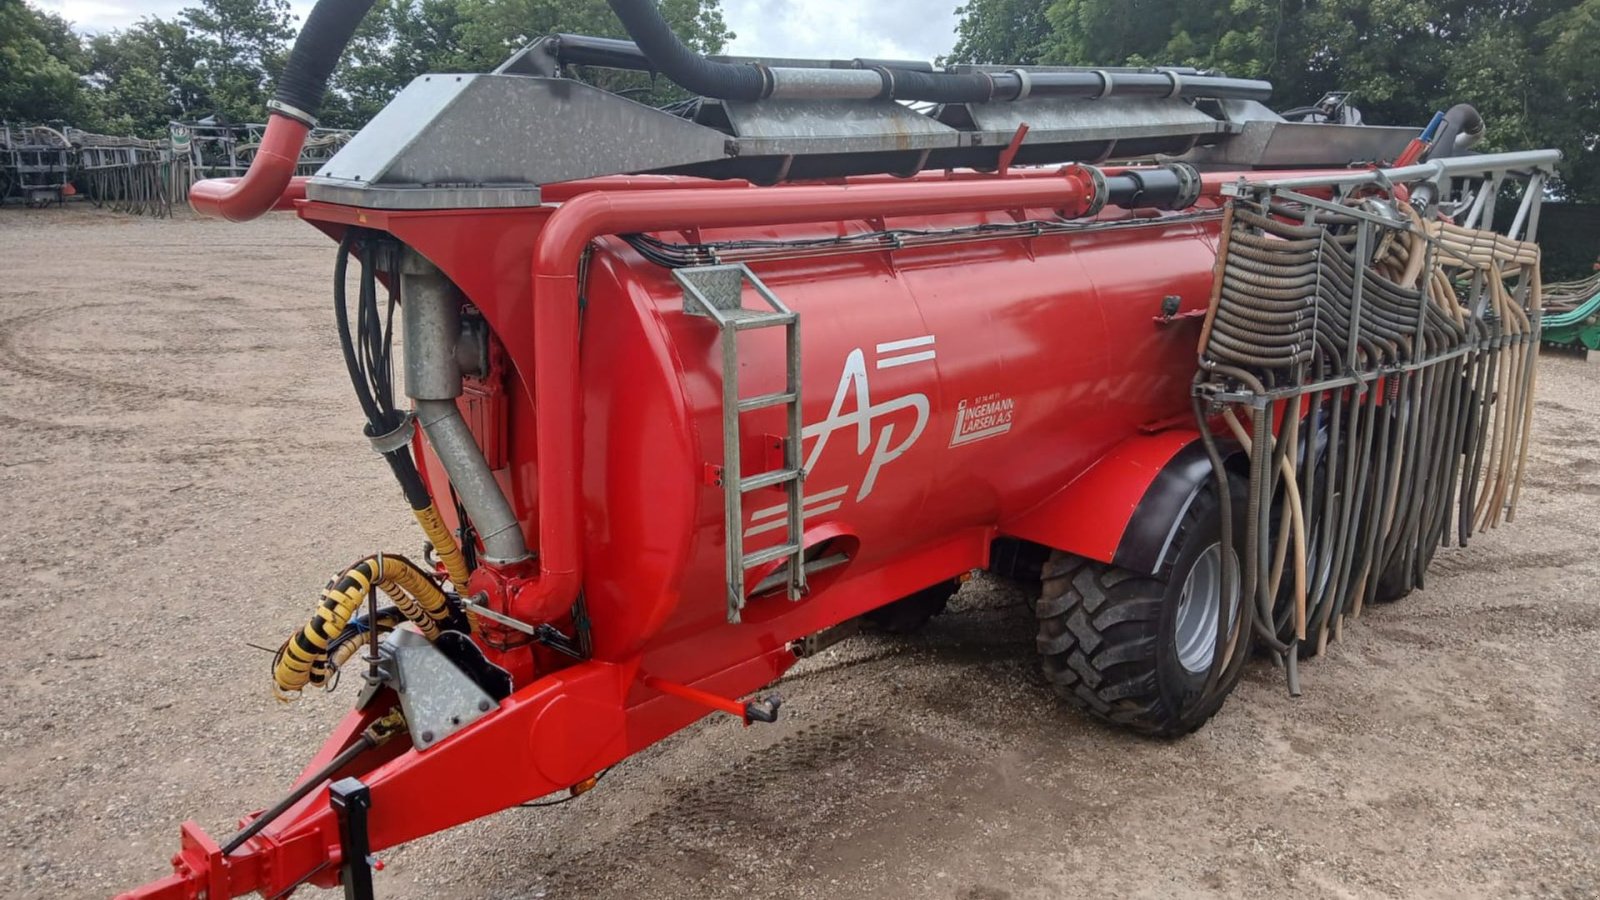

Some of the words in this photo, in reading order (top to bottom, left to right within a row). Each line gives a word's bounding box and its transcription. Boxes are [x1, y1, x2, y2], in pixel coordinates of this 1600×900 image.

[965, 398, 1015, 420] INGEMANN
[962, 413, 996, 434] LARSEN
[996, 410, 1013, 425] A/S
